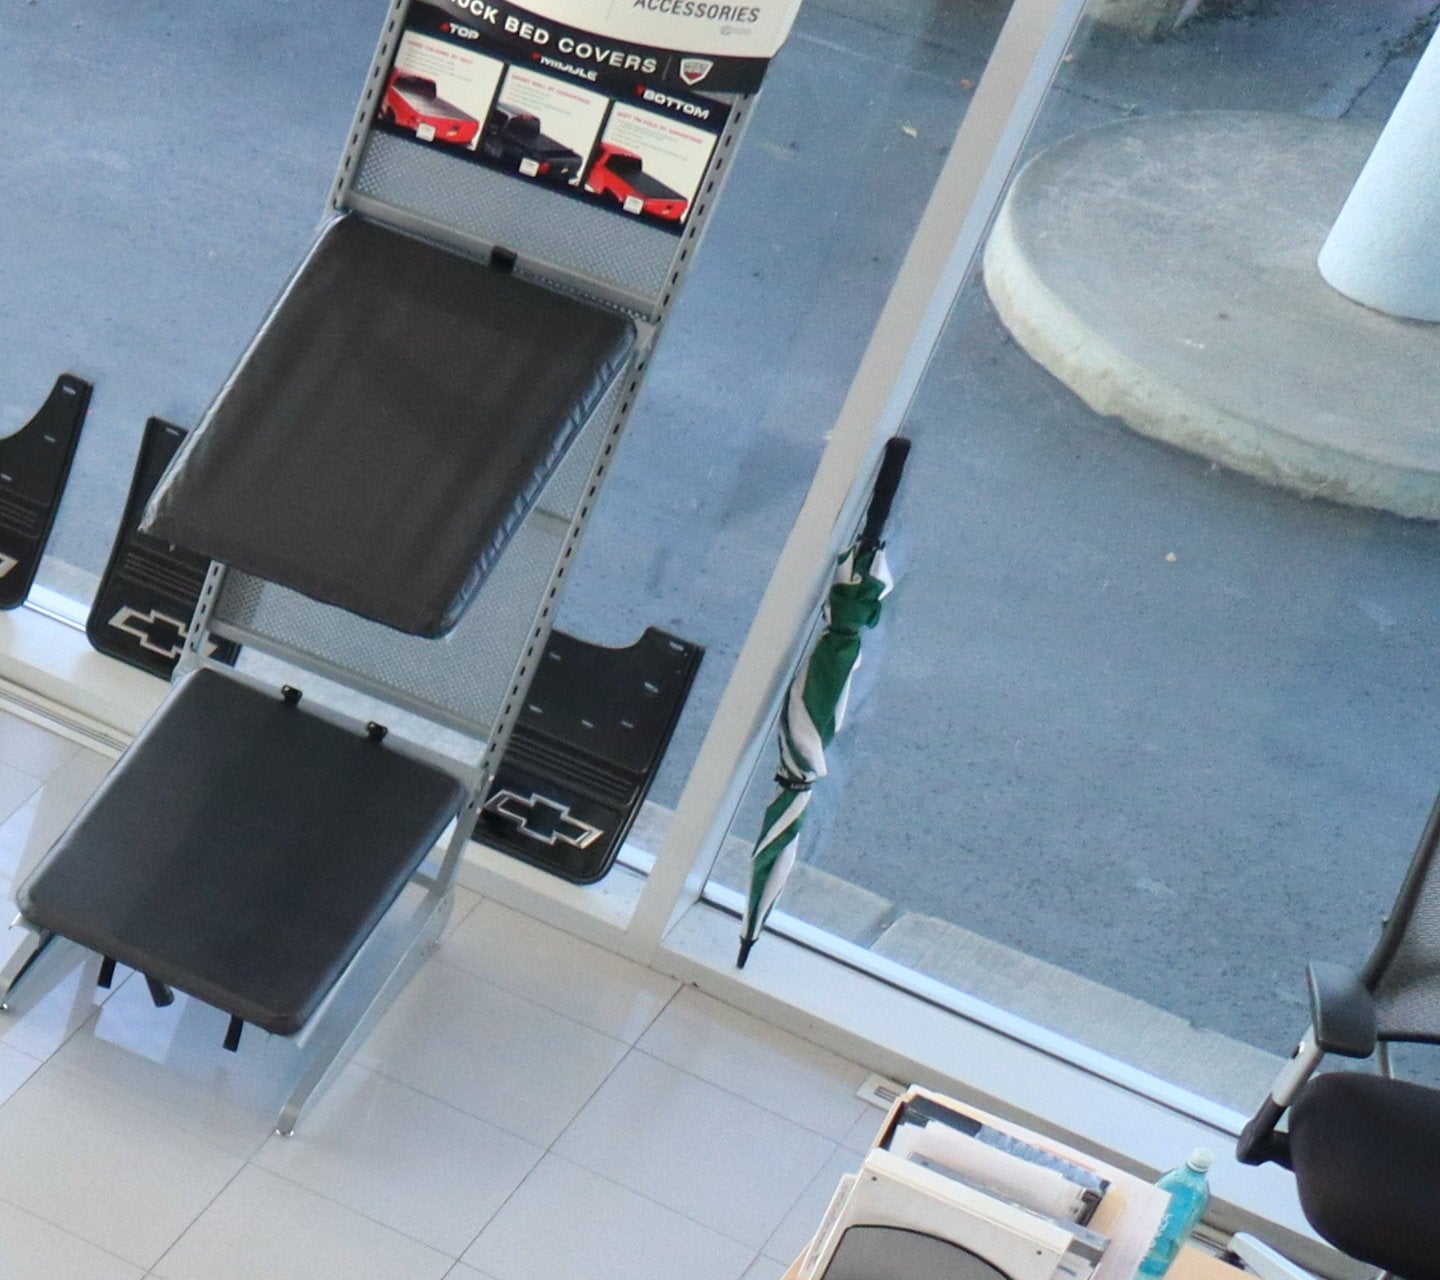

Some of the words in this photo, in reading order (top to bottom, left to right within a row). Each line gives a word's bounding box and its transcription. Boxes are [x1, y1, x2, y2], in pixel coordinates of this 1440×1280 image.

[449, 23, 480, 39] TOP
[451, 0, 499, 24] UCK
[504, 16, 550, 45] BED
[557, 37, 658, 74] COVERS
[540, 56, 598, 82] MIDDLE
[642, 89, 710, 120] BOTTOM
